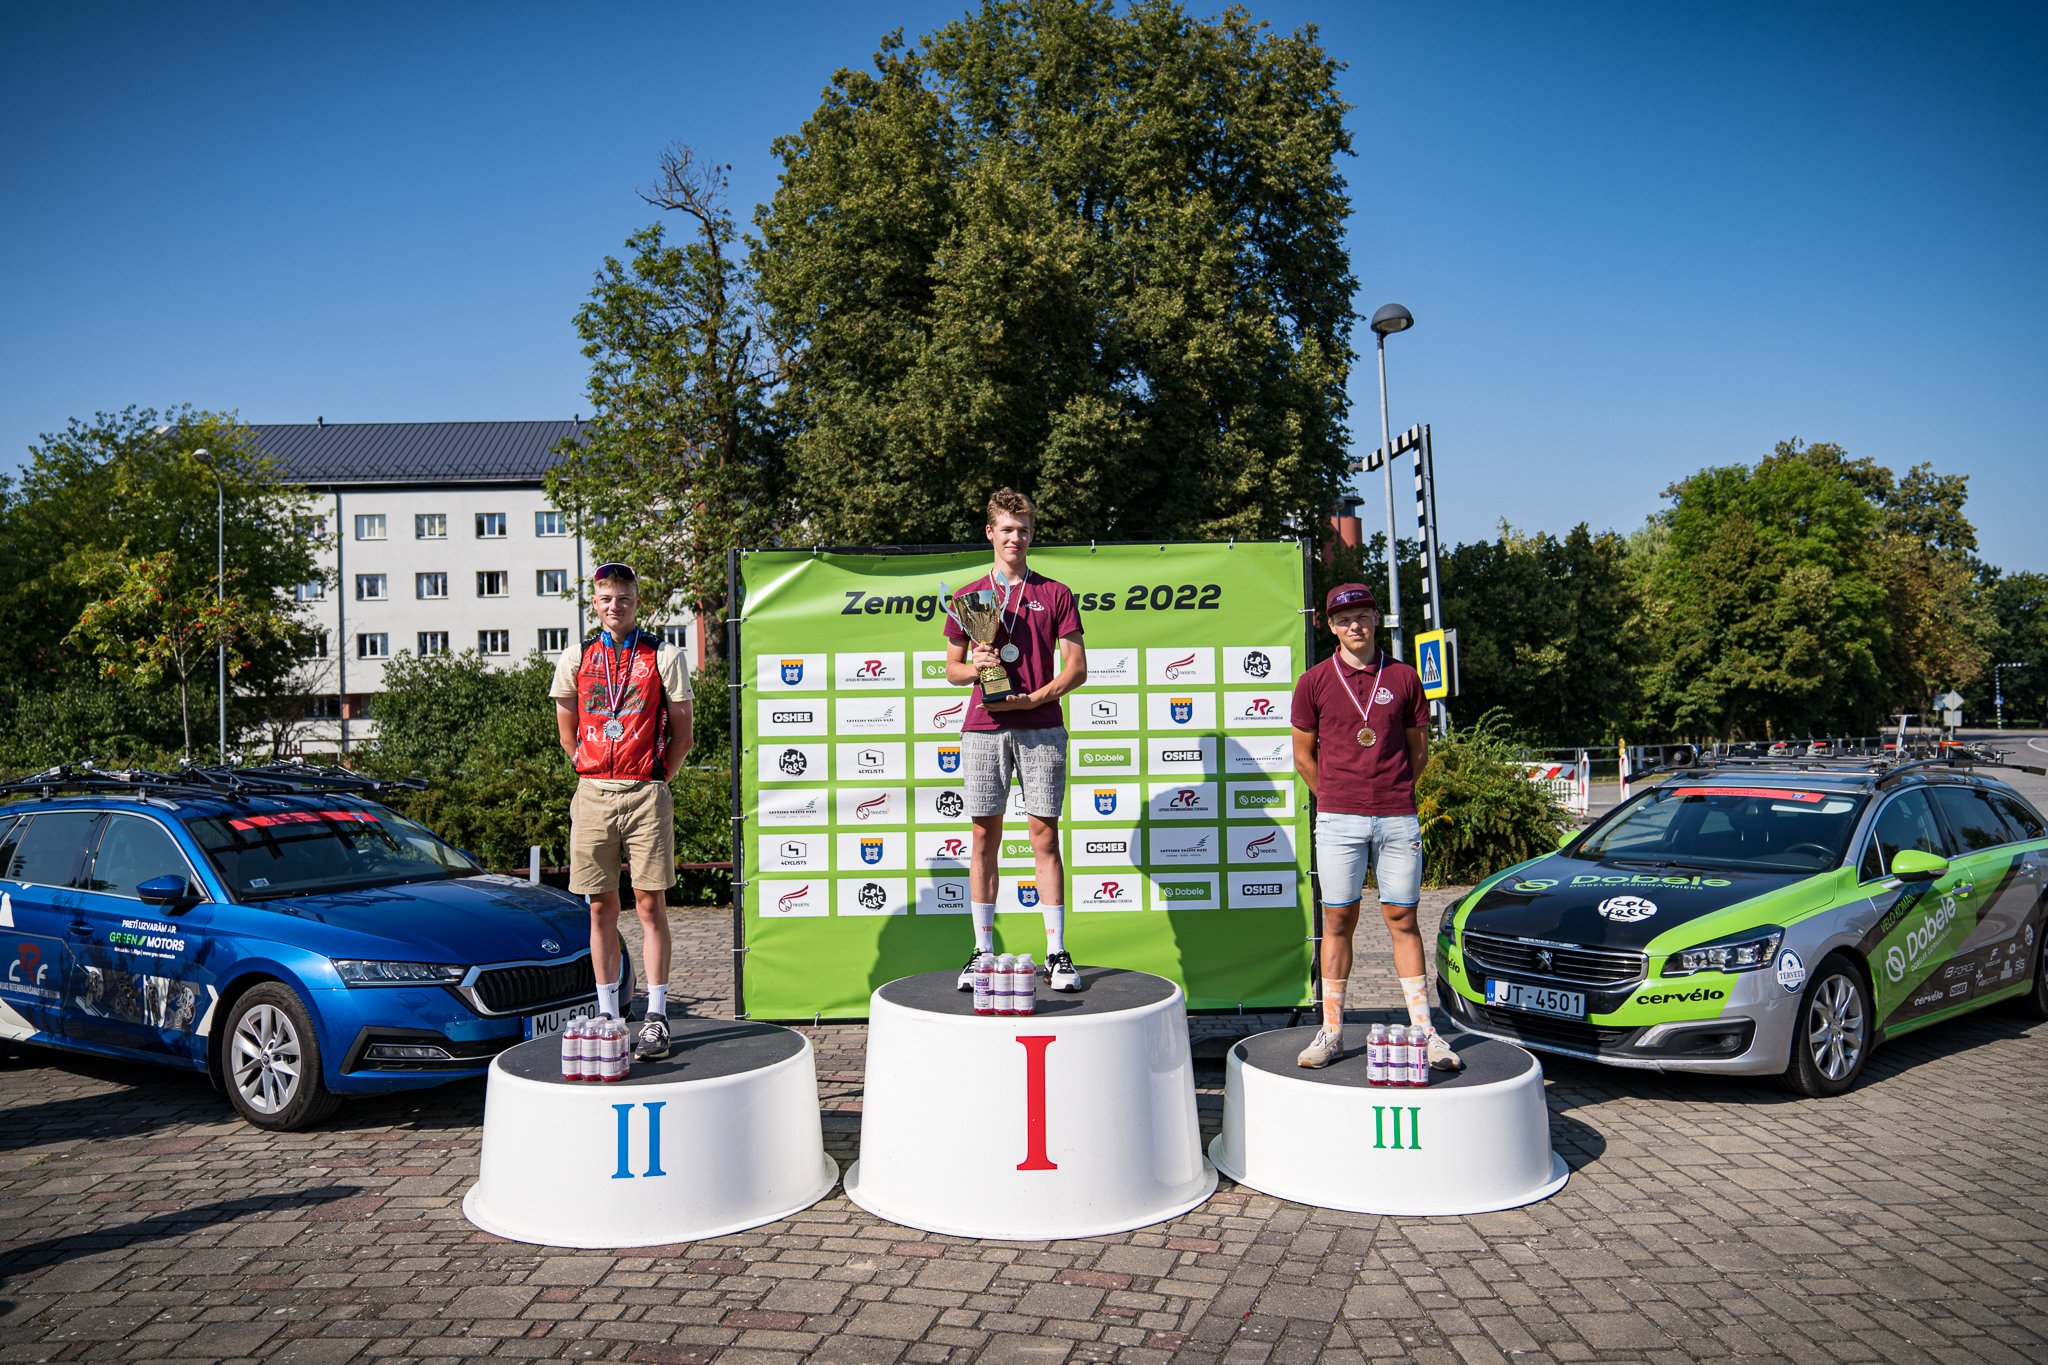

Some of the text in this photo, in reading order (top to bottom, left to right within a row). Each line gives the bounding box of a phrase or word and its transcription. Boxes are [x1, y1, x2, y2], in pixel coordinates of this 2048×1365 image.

[1125, 584, 1222, 610] 2022
[774, 713, 811, 722] OSHEE
[1095, 753, 1125, 762] Dobele
[1164, 752, 1200, 761] OSHEE
[1250, 796, 1280, 804] Dobele
[1088, 843, 1125, 853] OSHEE
[1571, 875, 1732, 887] Dobele
[1175, 888, 1204, 896] Dobele
[1244, 885, 1280, 894] OSHEE
[167, 925, 177, 934] AR
[1906, 896, 1956, 962] Dobele
[109, 931, 138, 945] GREEN
[146, 936, 185, 952] MOTORS
[1500, 985, 1580, 1013] JT-4501
[1636, 988, 1725, 1005] cervélo
[1913, 990, 1944, 1006] cervélo
[1016, 1036, 1057, 1170] I
[1372, 1106, 1422, 1150] III
[612, 1101, 666, 1179] II
